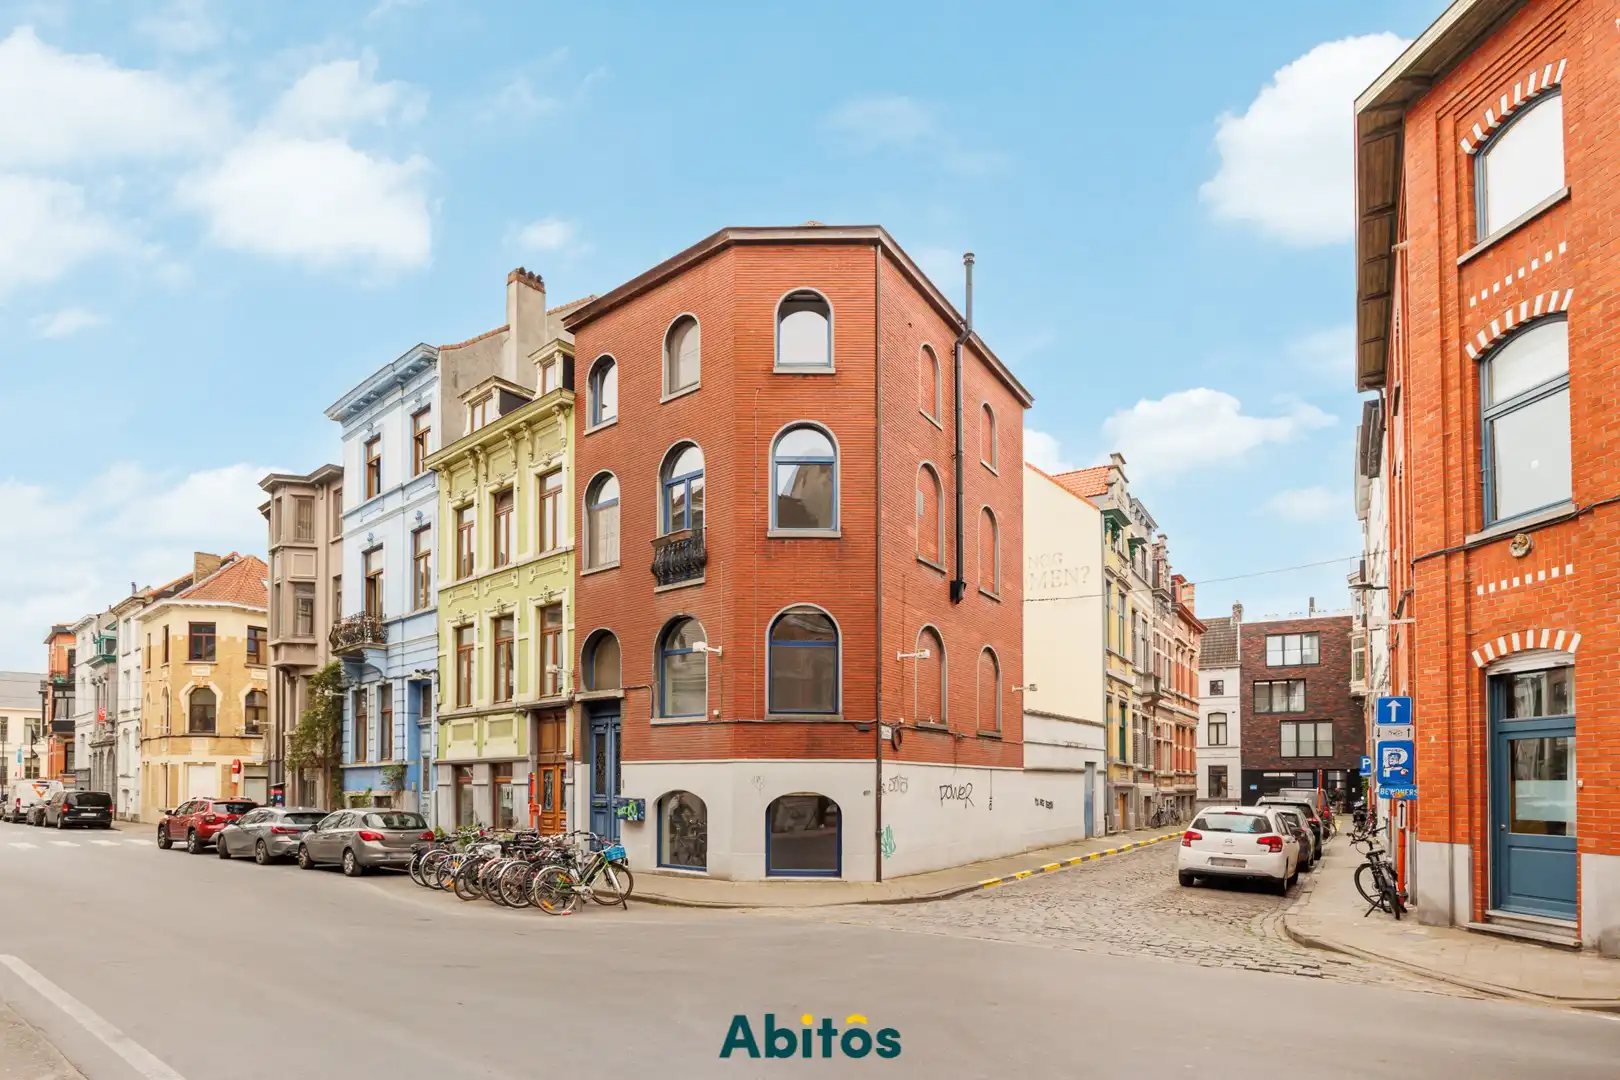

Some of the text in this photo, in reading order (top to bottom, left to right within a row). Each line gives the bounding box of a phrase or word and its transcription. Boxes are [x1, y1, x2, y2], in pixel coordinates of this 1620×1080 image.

[1028, 552, 1063, 569] NOG
[1362, 758, 1370, 769] P
[1383, 747, 1408, 778] P
[1380, 788, 1417, 796] BEWONERS
